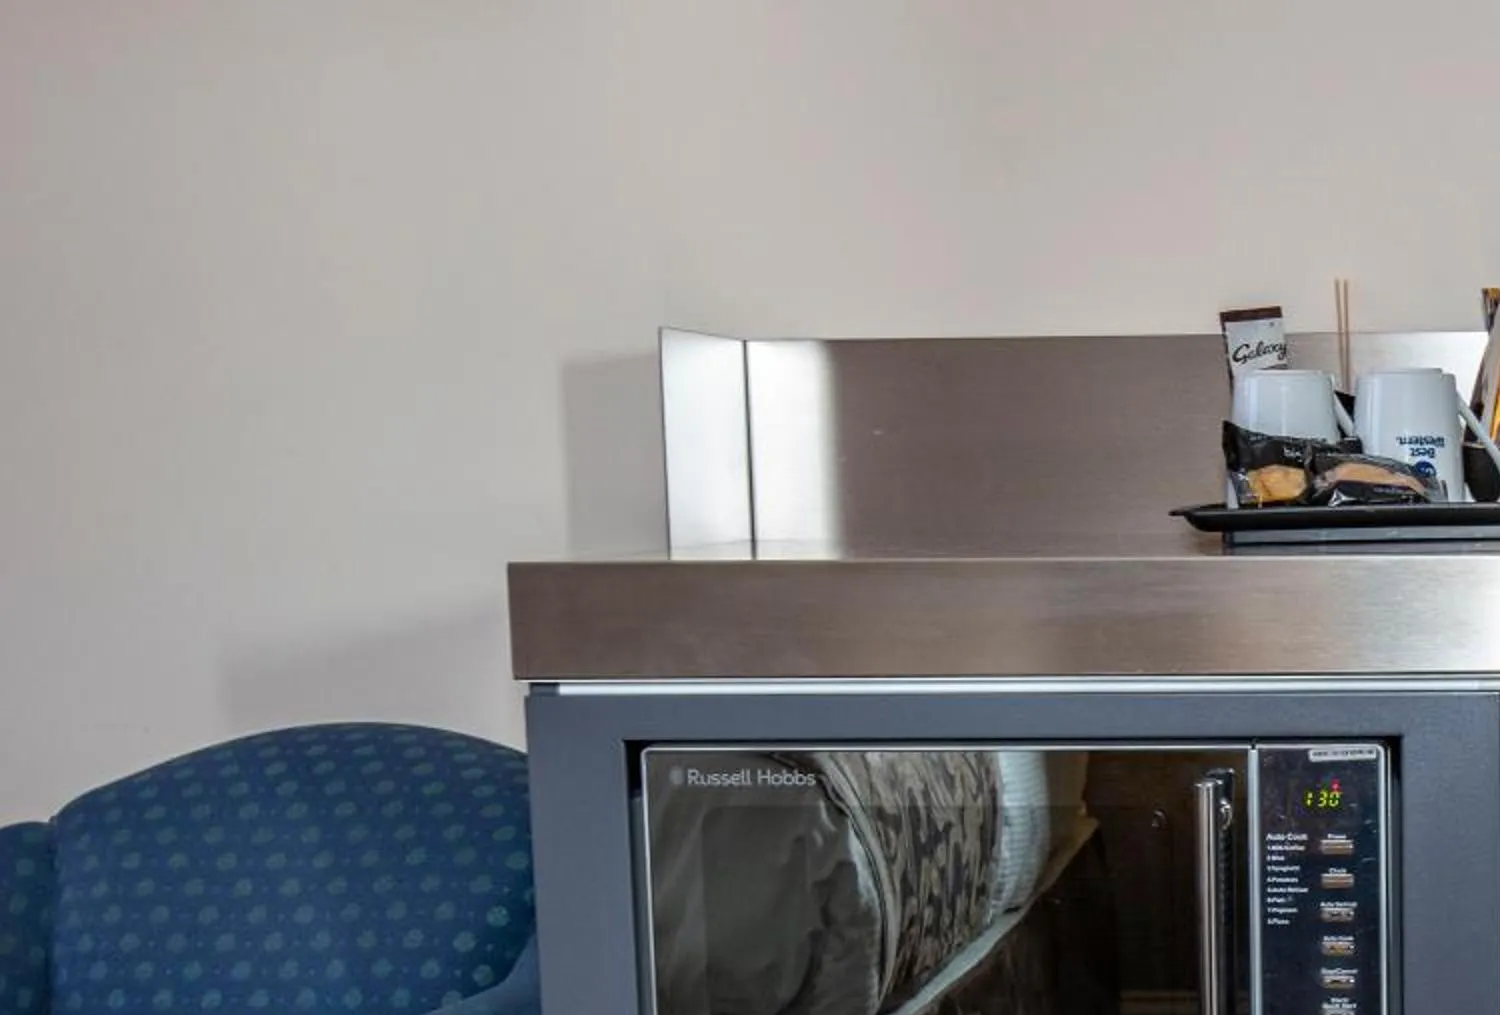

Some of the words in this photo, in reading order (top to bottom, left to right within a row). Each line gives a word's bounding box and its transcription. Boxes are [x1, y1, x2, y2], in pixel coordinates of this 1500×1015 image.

[1232, 341, 1287, 364] Galaxy
[687, 768, 750, 786] Russell
[757, 768, 817, 786] Hobbs
